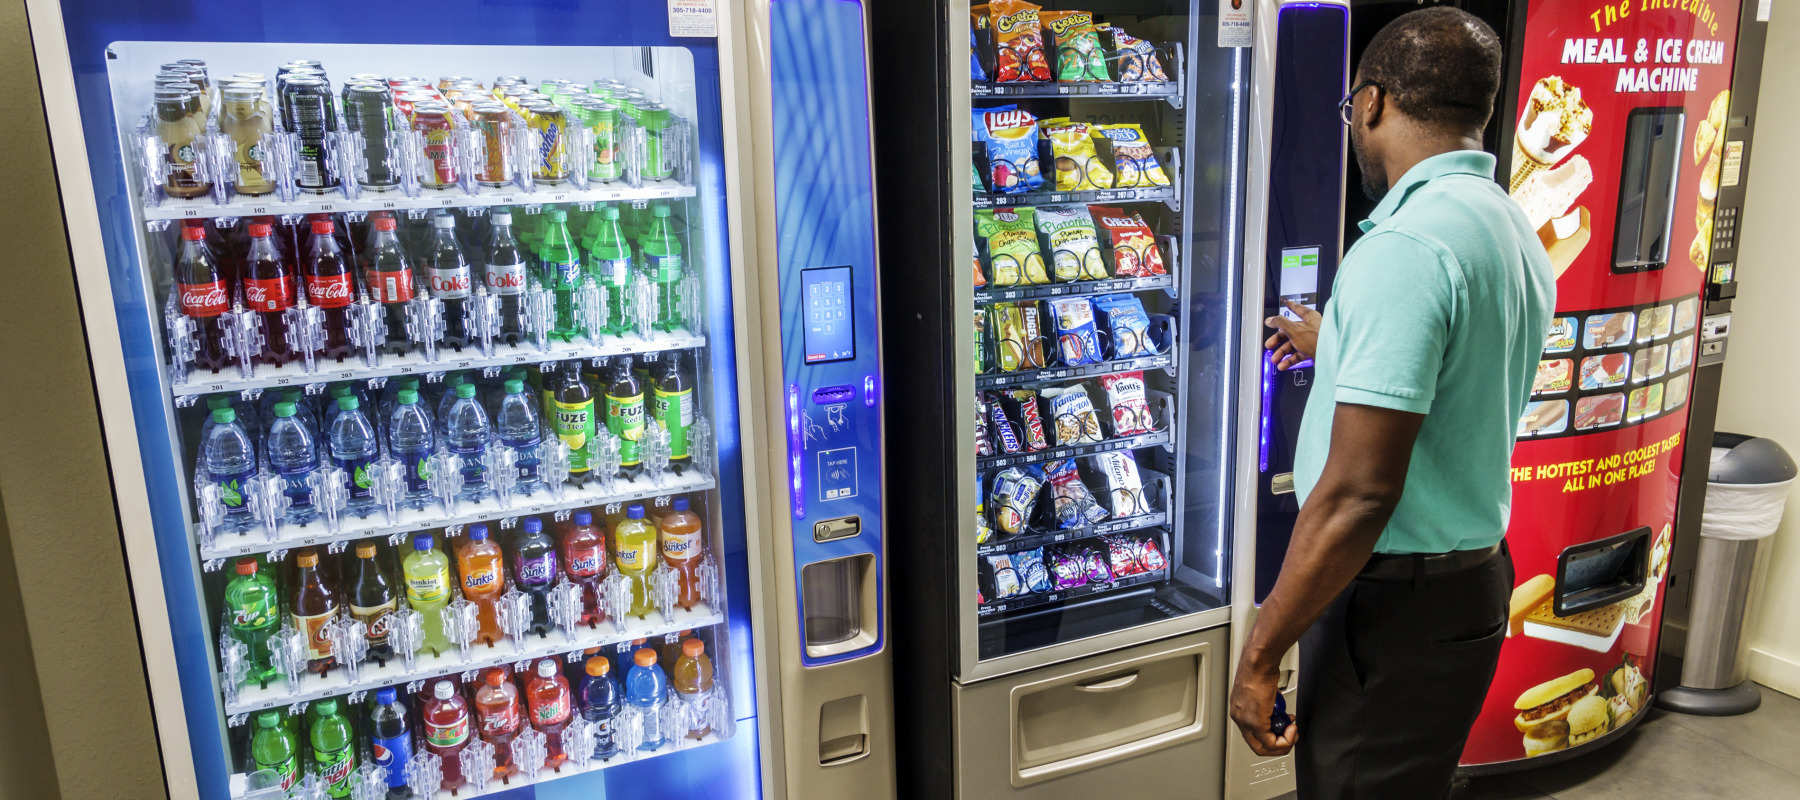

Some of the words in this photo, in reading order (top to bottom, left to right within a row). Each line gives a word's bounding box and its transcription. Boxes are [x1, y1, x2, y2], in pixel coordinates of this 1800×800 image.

[1000, 10, 1039, 32] Cheetos
[1051, 14, 1090, 34] Cheetos
[1590, 0, 1630, 32] The
[1561, 38, 1628, 64] MEAL
[1634, 38, 1648, 64] &
[1654, 38, 1682, 64] ICE
[1686, 39, 1724, 64] CREAM
[1614, 68, 1698, 92] MACHINE
[309, 280, 349, 298] Coca-Cola
[431, 276, 469, 292] Coke
[487, 272, 523, 288] Coke
[183, 288, 226, 307] Coca-Cola
[656, 400, 668, 411] ZE
[556, 411, 586, 423] FUZE
[1023, 397, 1044, 441] TWIX
[995, 407, 1019, 449] SNICKERS
[1510, 468, 1532, 481] THE
[1537, 460, 1594, 480] HOTTEST
[1596, 454, 1620, 471] AND
[1624, 443, 1660, 466] COOLEST
[1662, 432, 1680, 453] TASTES
[1562, 478, 1584, 493] ALL
[1589, 474, 1600, 488] IN
[1604, 469, 1626, 485] ONE
[1629, 459, 1655, 479] PLACE!
[664, 540, 692, 551] Sunkist
[465, 570, 496, 588] Sunkis
[539, 704, 558, 722] Nehi
